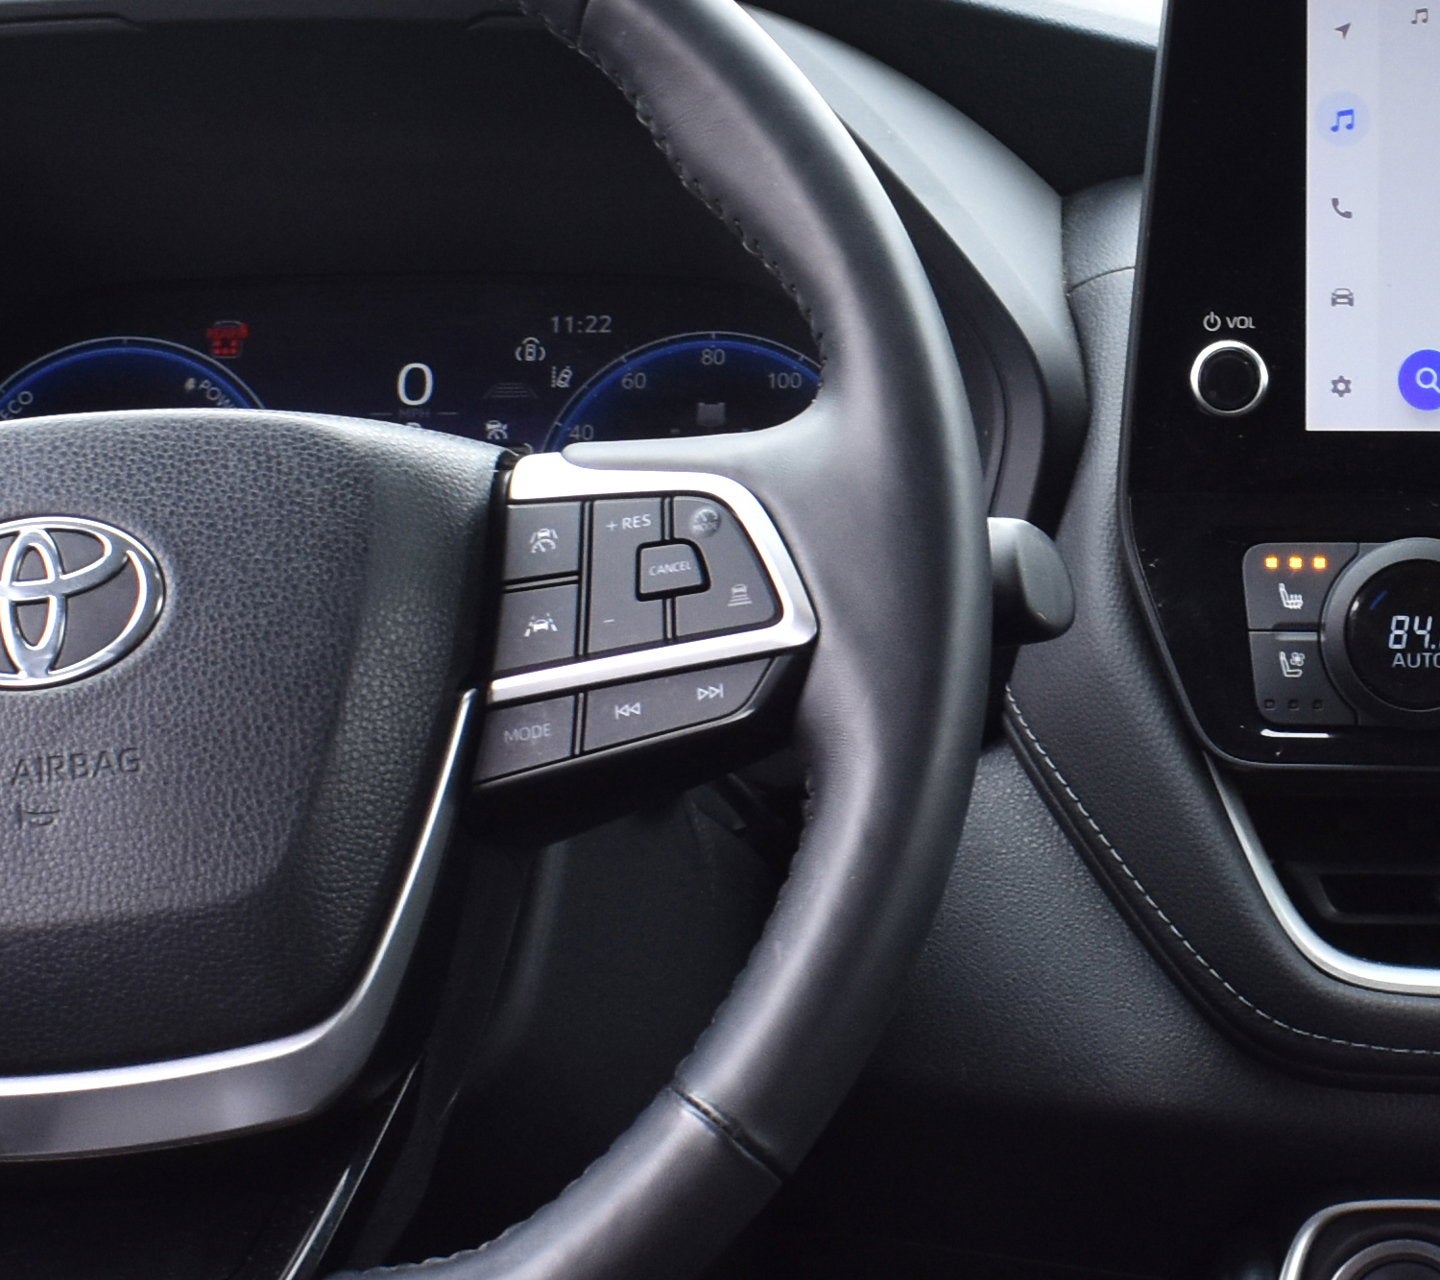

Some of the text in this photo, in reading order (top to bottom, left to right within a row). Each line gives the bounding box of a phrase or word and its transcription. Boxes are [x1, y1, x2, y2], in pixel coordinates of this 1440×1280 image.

[551, 315, 612, 333] 11:22
[1225, 316, 1256, 329] VOL
[701, 349, 725, 365] 80
[621, 372, 646, 389] 60
[768, 372, 802, 389] 100
[569, 424, 594, 441] 40
[622, 514, 652, 530] RES
[648, 560, 692, 576] CANCEL
[503, 722, 552, 744] MODE
[11, 747, 142, 786] AIRBAG
